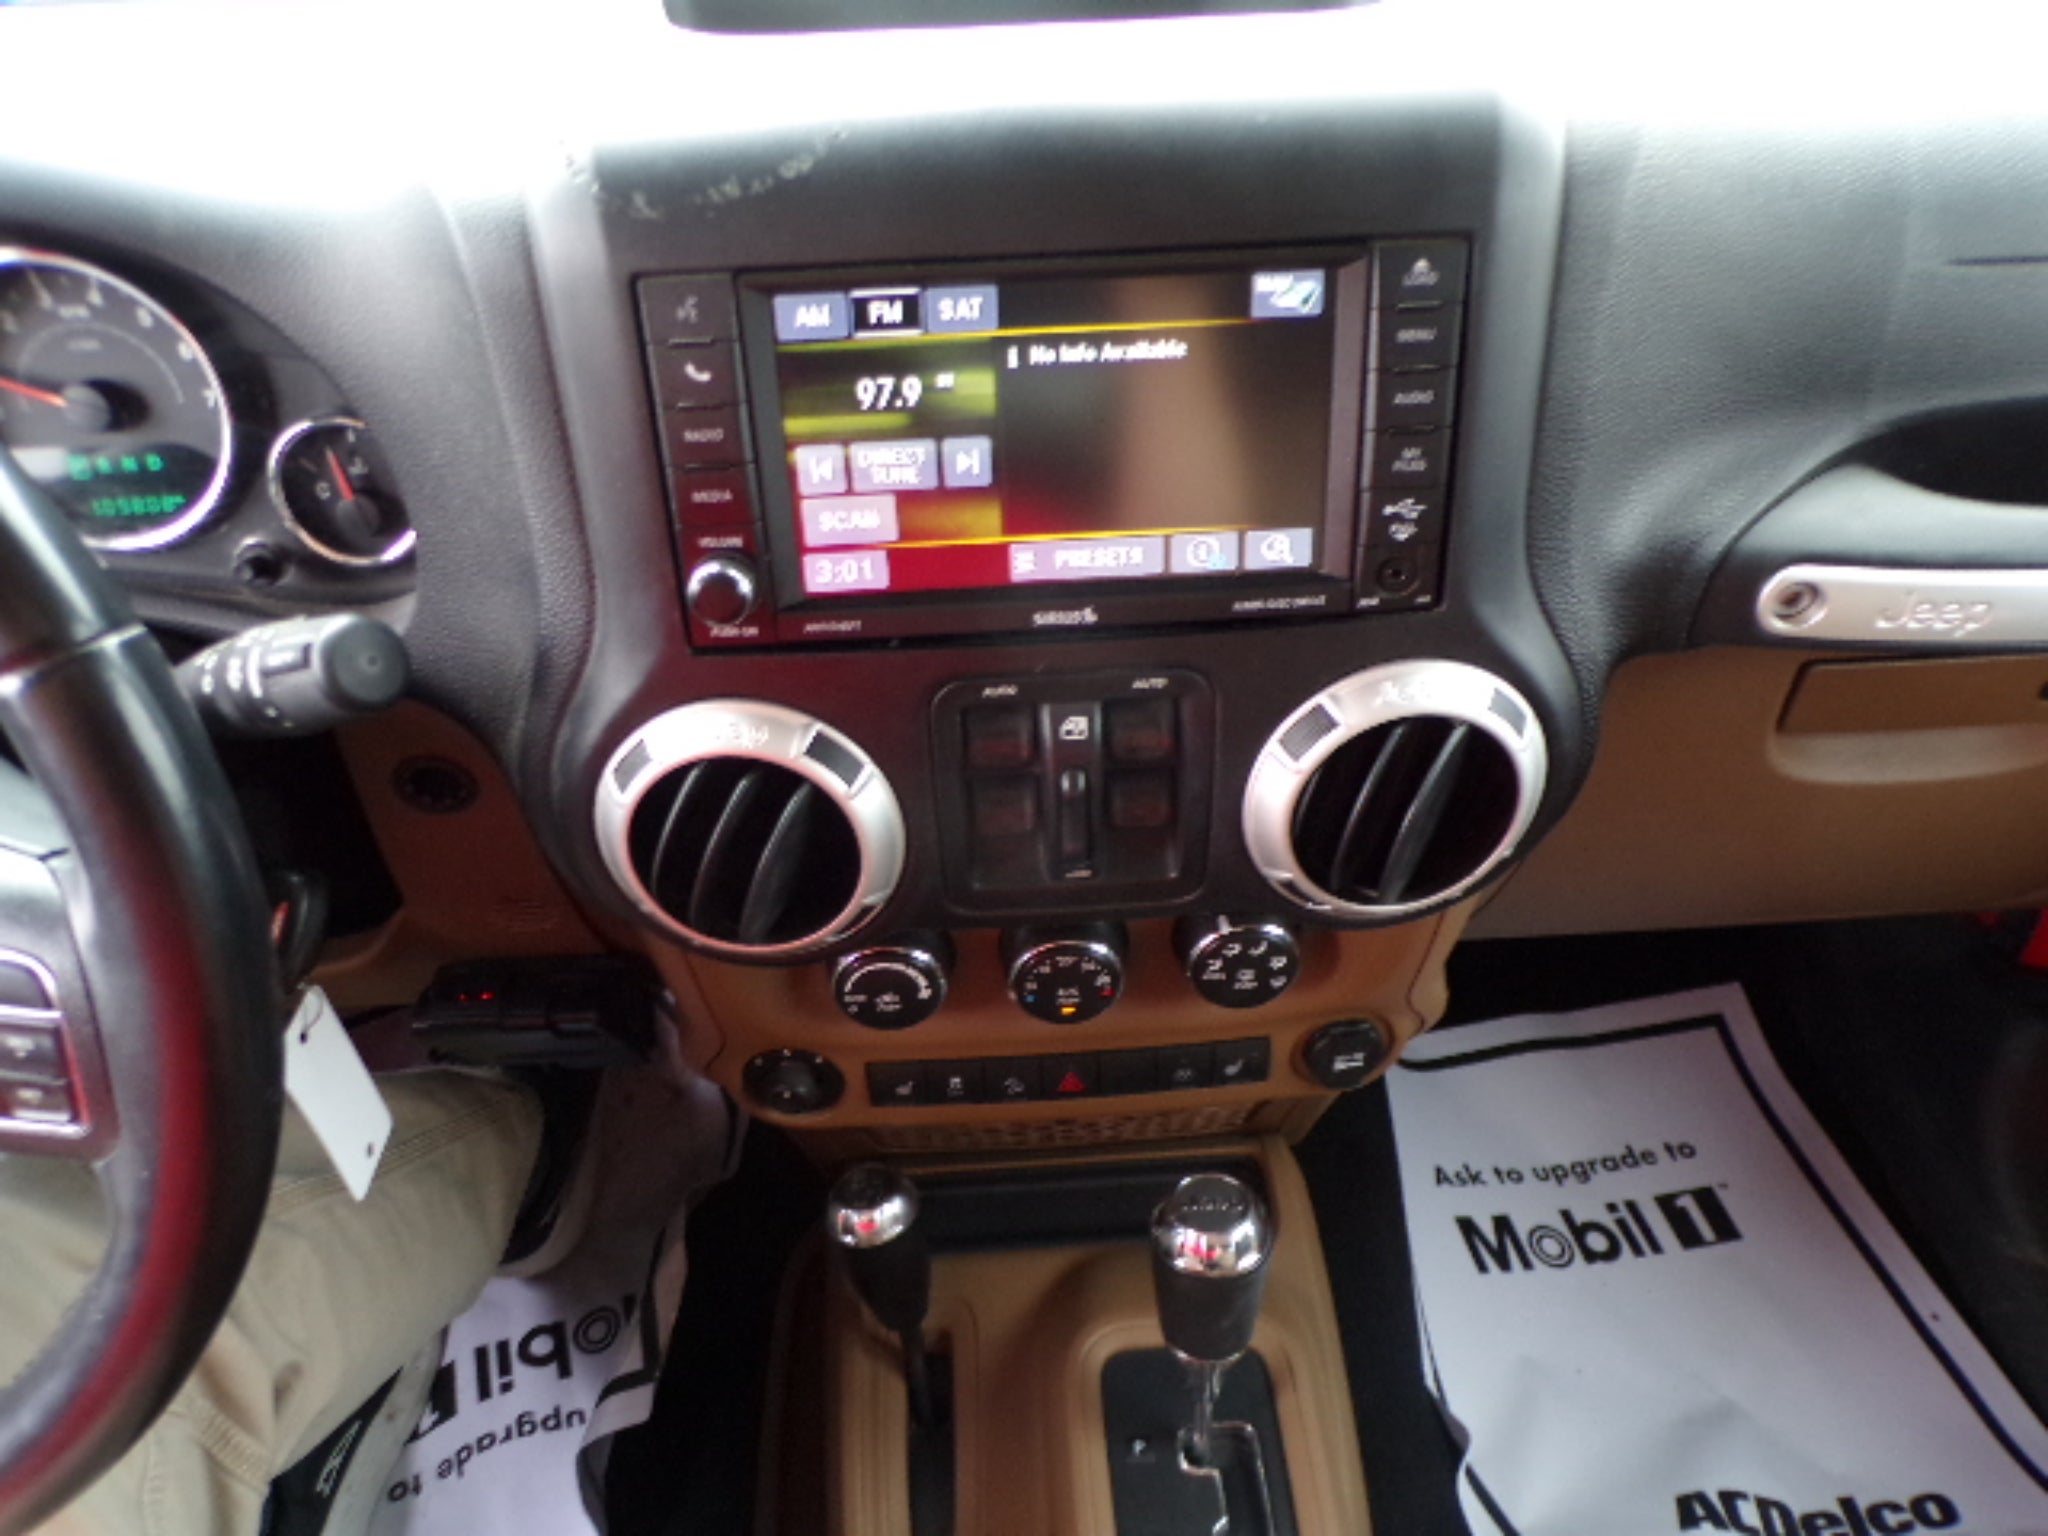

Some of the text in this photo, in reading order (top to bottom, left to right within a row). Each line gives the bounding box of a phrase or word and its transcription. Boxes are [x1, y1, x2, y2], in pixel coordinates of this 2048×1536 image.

[795, 305, 831, 328] AM
[867, 299, 904, 325] FM
[937, 296, 984, 322] SAT
[855, 376, 923, 411] 97.9
[818, 508, 881, 533] SCAN
[814, 557, 874, 584] 3:01
[1053, 546, 1144, 570] PRESETS
[1874, 586, 1995, 638] Jeep
[1433, 1141, 1698, 1188] Ask to upgrade to
[1454, 1188, 1734, 1275] Mobil 1
[473, 1294, 640, 1403] obil
[387, 1404, 588, 1502] upgrade to
[1675, 1489, 1962, 1536] ACDelco
